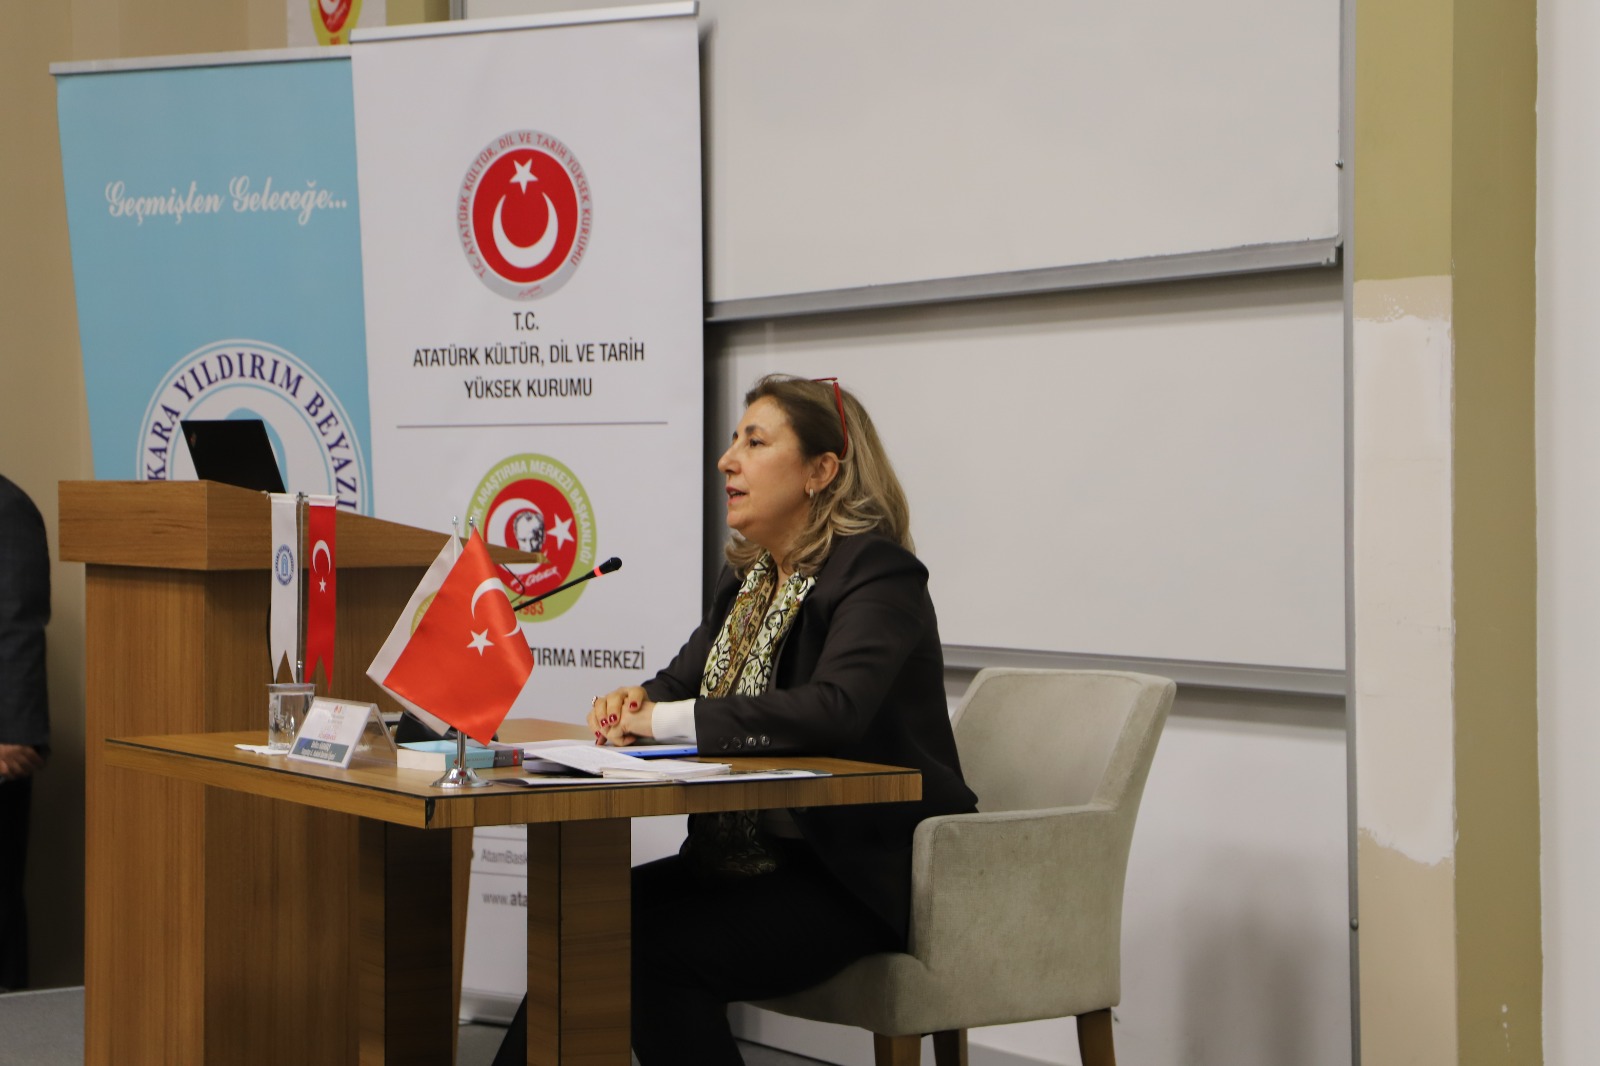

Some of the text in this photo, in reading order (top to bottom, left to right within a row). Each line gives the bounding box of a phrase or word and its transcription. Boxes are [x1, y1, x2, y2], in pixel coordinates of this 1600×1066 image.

[518, 132, 531, 144] VE
[537, 133, 567, 158] TARİH
[567, 154, 590, 204] YÜKSEK
[105, 175, 347, 226] Geçmişten Geleceğe...
[570, 208, 592, 266] KURUMU
[513, 311, 540, 331] T.C.
[413, 337, 645, 367] ATATÜRK KÜLTÜR, DİL VE TARİH
[173, 352, 304, 402] YILDIRIM
[464, 376, 593, 399] YÜKSEK KURUMU
[580, 645, 645, 670] MERKEZİ
